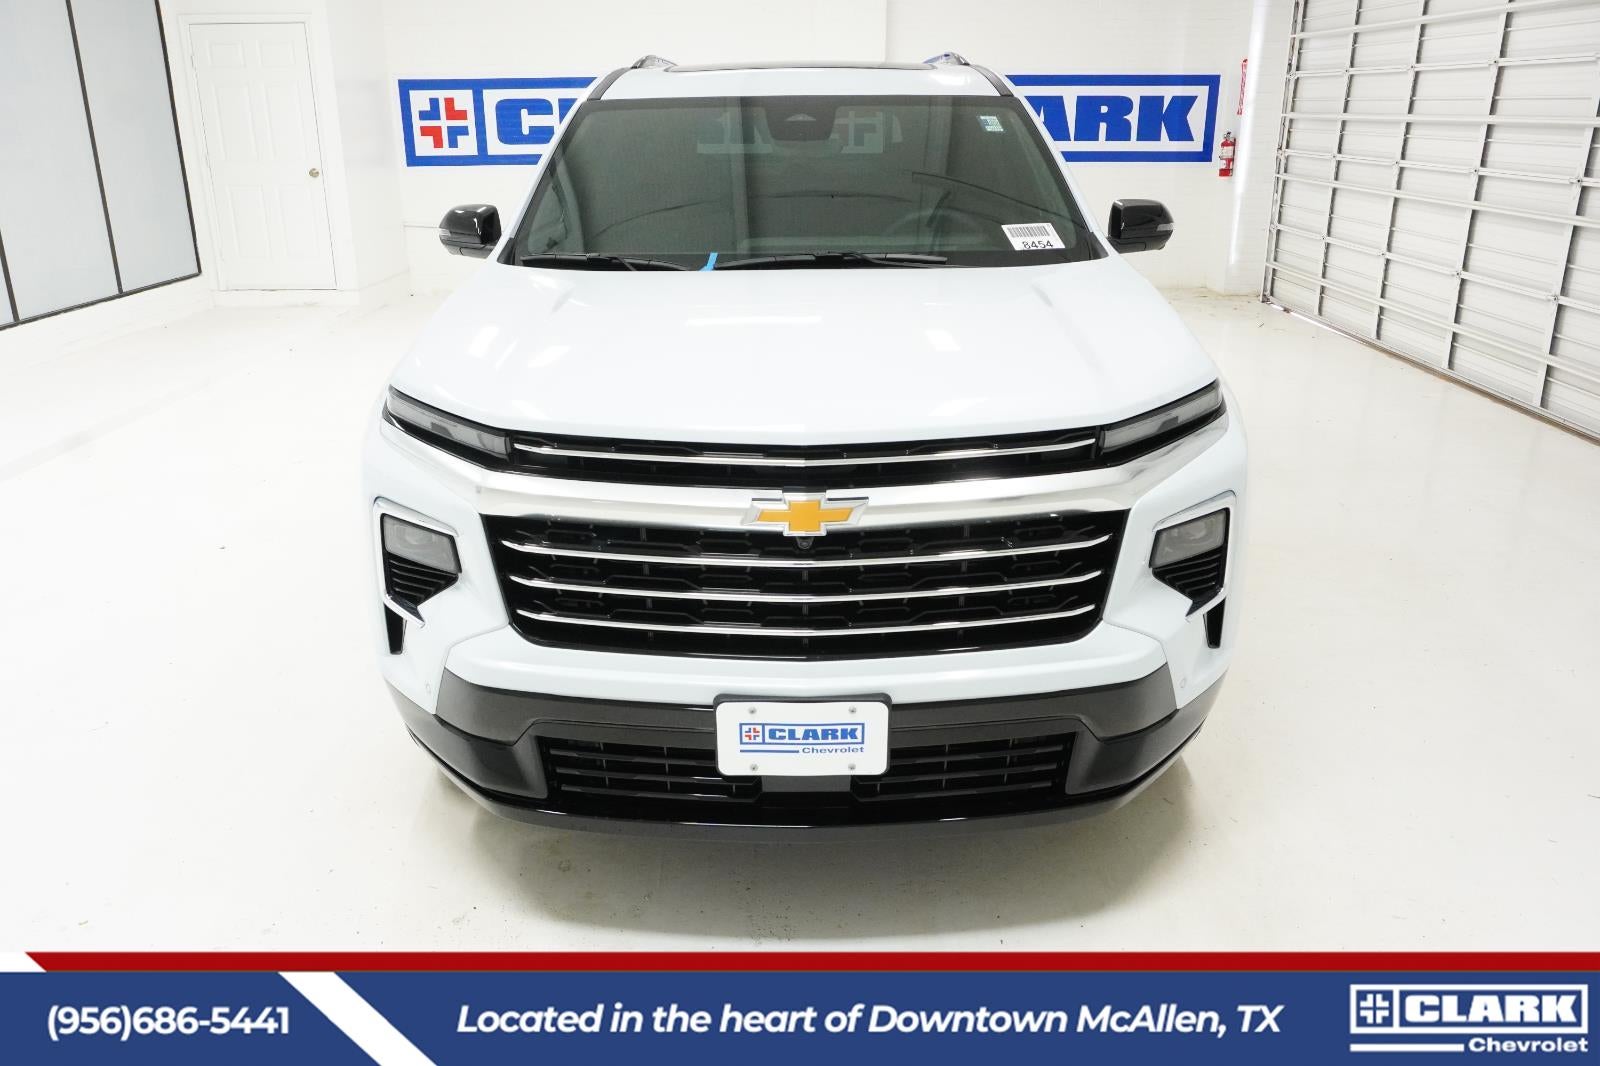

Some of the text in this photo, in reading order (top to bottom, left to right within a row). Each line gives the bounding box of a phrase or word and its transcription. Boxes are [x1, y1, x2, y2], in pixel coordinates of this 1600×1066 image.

[1022, 240, 1054, 249] 8454
[768, 728, 858, 740] CLARK
[802, 746, 864, 754] Chevrolet
